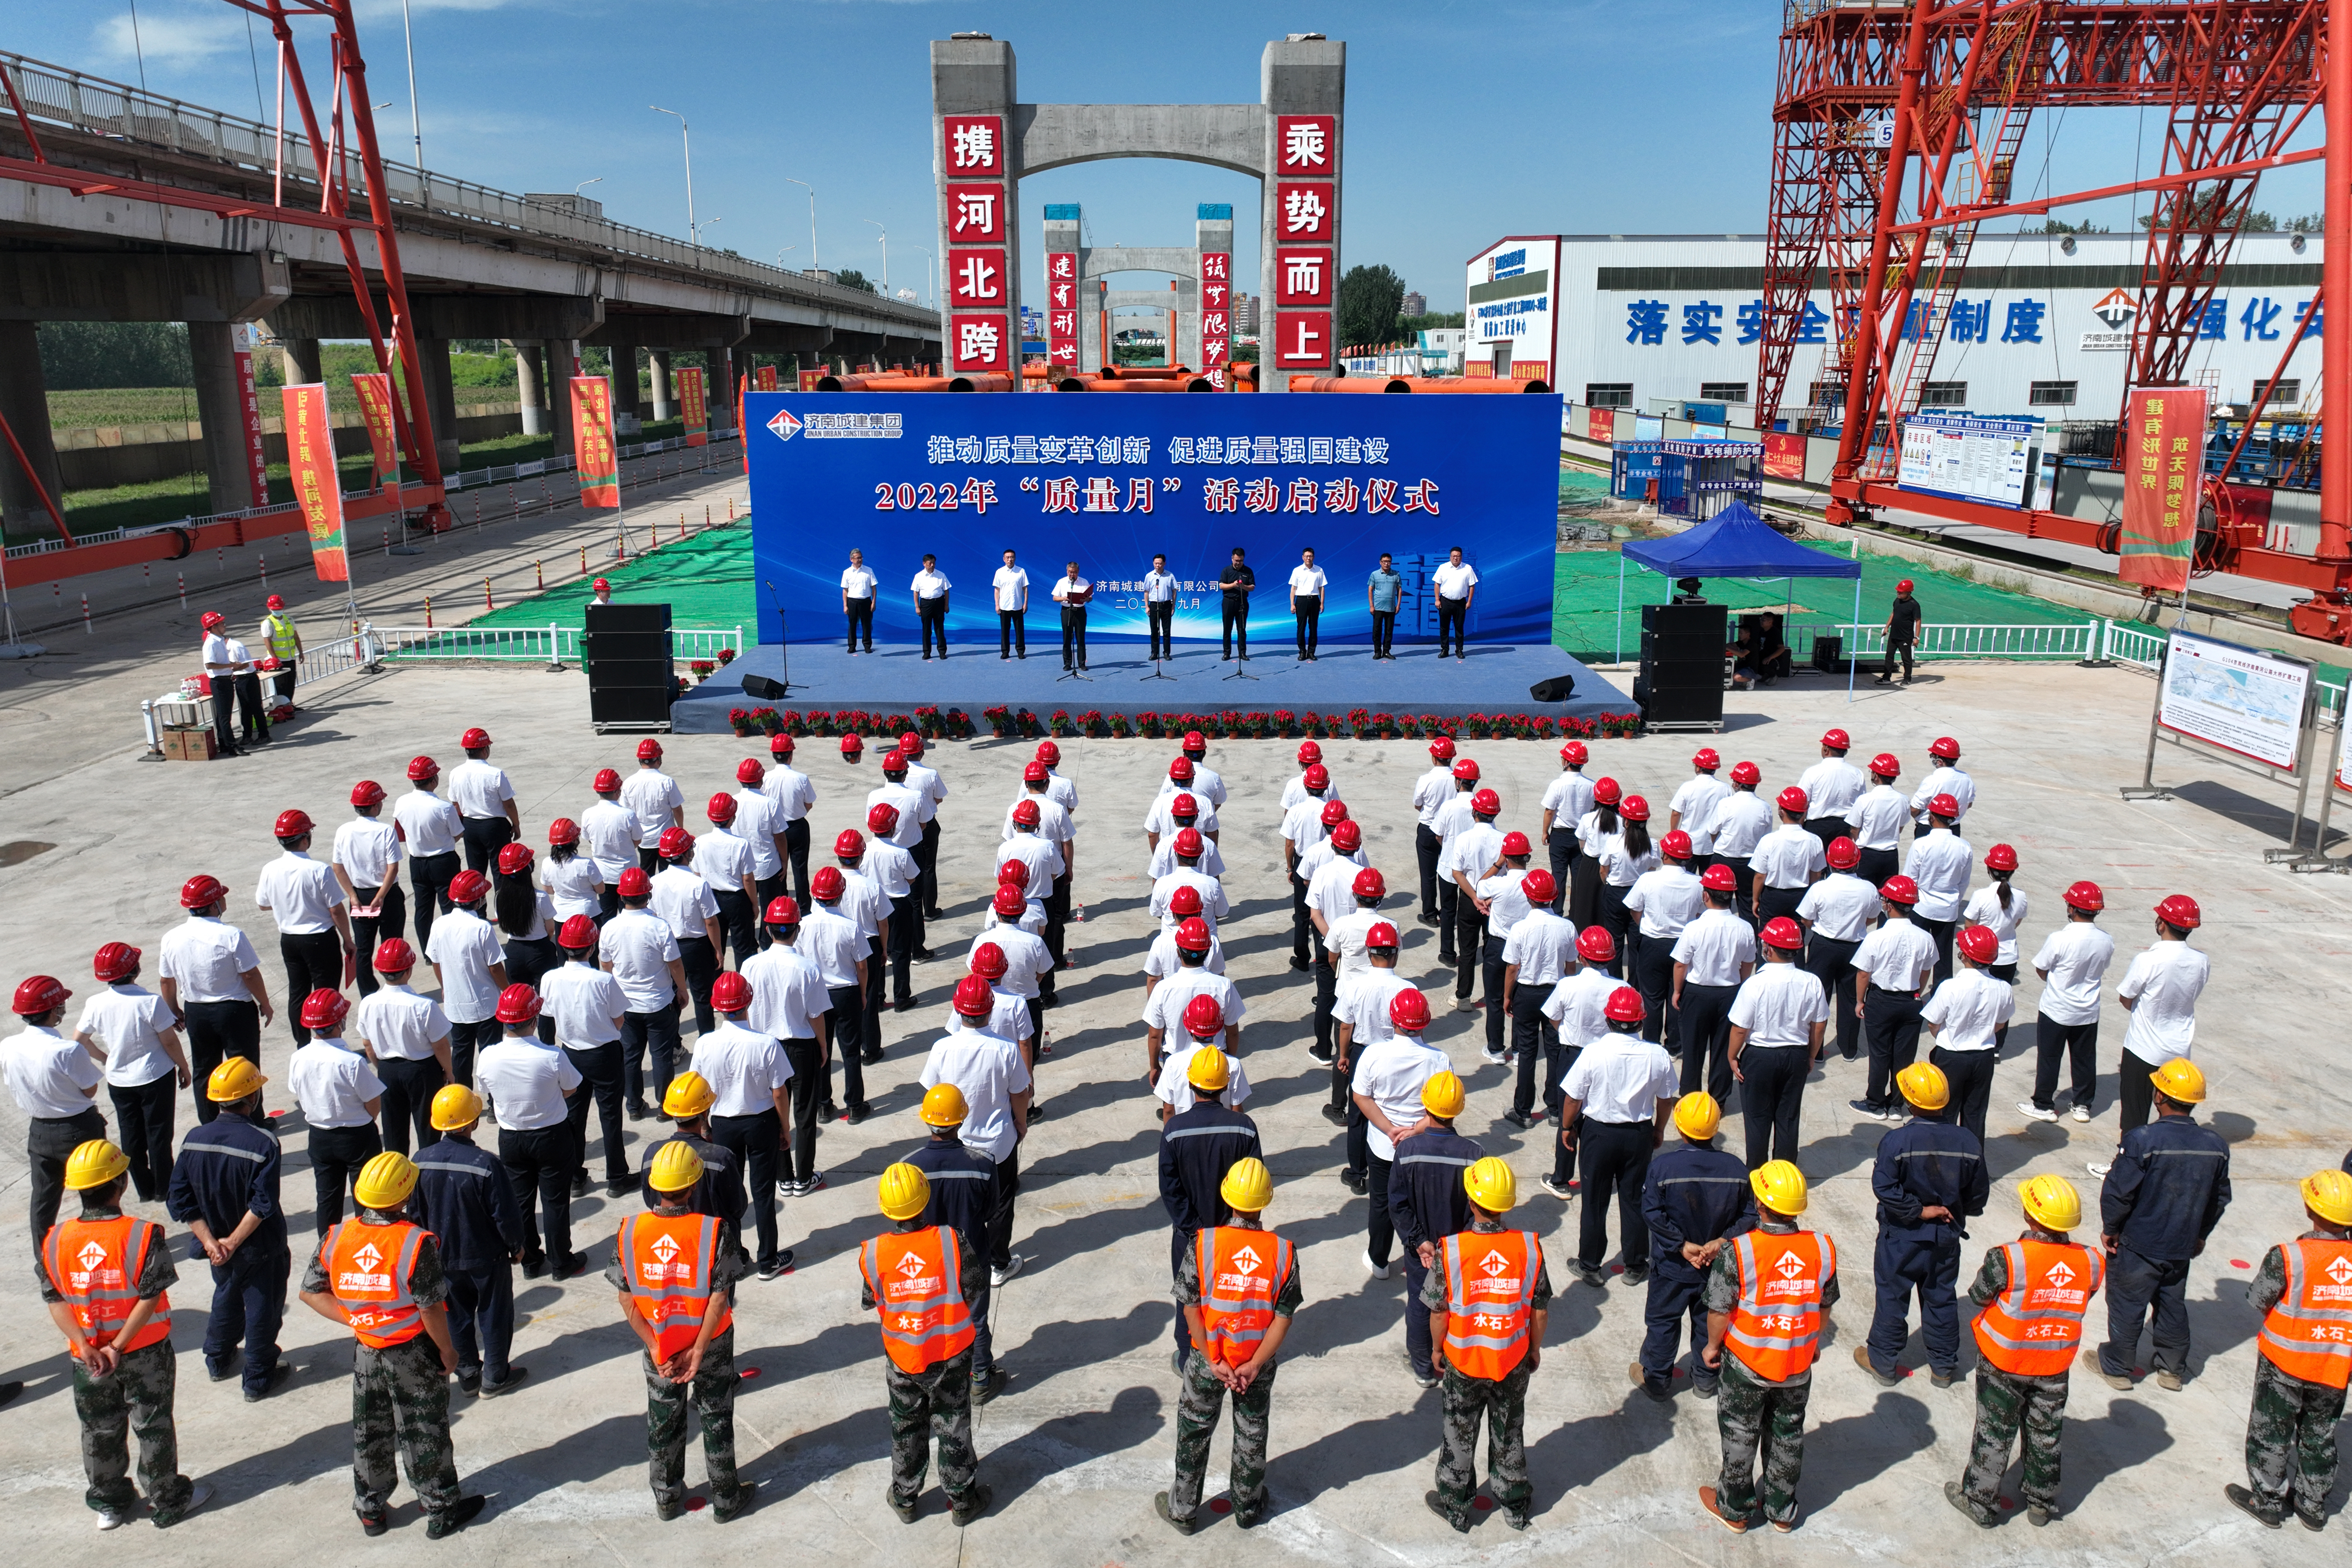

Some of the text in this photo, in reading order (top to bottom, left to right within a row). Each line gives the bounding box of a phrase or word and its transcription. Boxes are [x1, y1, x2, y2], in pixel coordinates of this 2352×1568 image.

[1882, 127, 1892, 141] 5
[953, 124, 999, 363] 携河北跨
[1284, 123, 1326, 359] 乘势而上
[1626, 298, 2046, 345] 落实安全章制度
[804, 413, 902, 429] 济南城建集团
[244, 359, 268, 505] 质量是企业的根本
[805, 430, 902, 438] JINAN URBAN CONSTRUCTION GROUP
[1907, 432, 1931, 444] 吊装区域
[927, 436, 1389, 464] 推动质量变革创新 促进质量强国建设
[1704, 446, 1761, 456] 配电箱防护棚
[1764, 452, 1781, 463] 迎二十大
[642, 1262, 690, 1275] 济南城建
[339, 1273, 390, 1286] 济南城建
[889, 1276, 940, 1292] 济南城建
[1218, 1274, 1270, 1289] 济南城建
[1470, 1277, 1520, 1292] 济南城建
[1765, 1279, 1815, 1292] 济南城建
[2032, 1288, 2085, 1300] 济南城建
[349, 1310, 393, 1326] 水石工
[898, 1312, 938, 1331] 水石工
[1217, 1315, 1255, 1330] 水石工
[1474, 1313, 1515, 1330] 水石工
[1761, 1315, 1805, 1331] 水石工
[2025, 1324, 2069, 1338] 水石工
